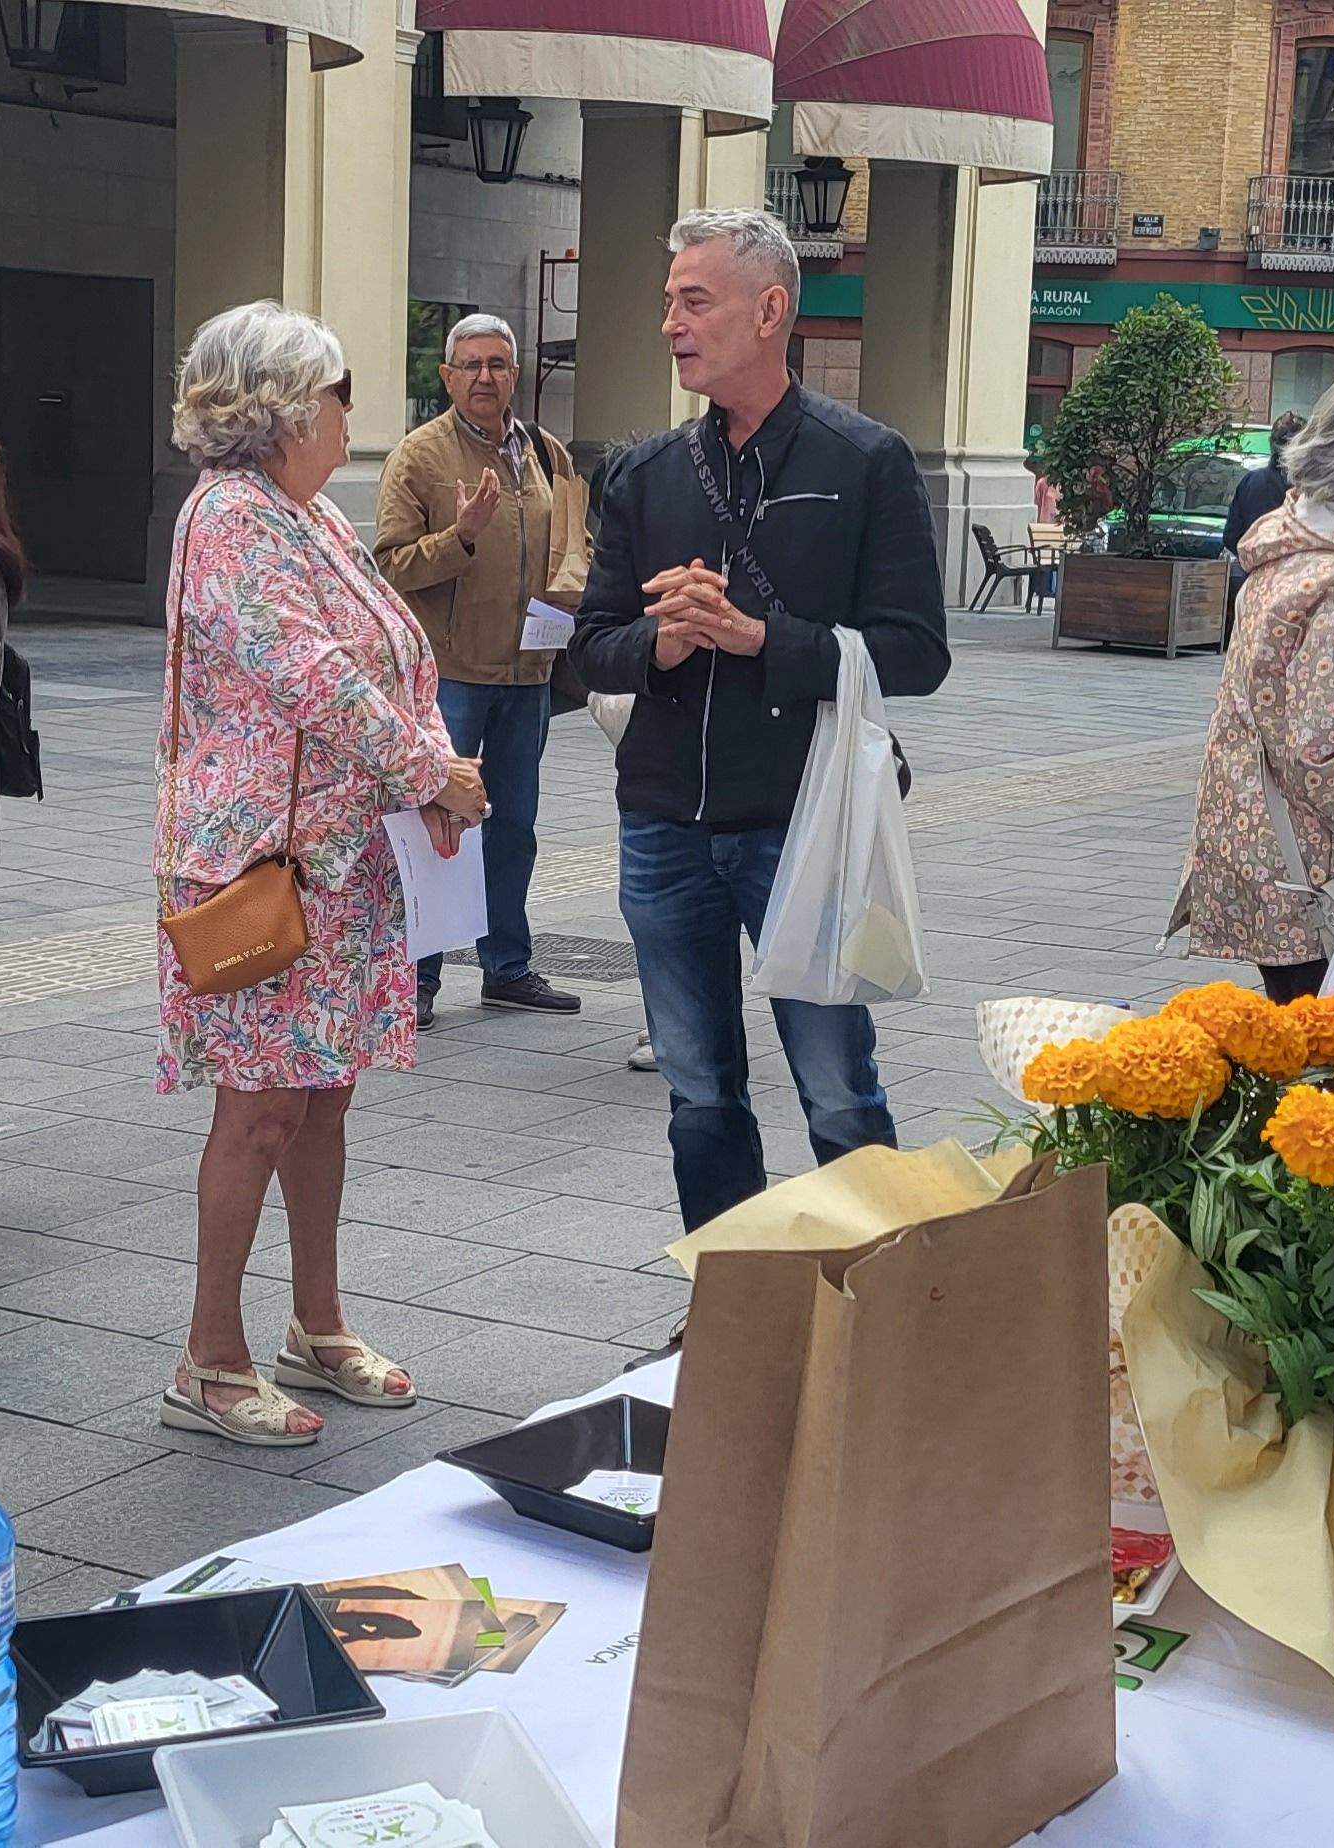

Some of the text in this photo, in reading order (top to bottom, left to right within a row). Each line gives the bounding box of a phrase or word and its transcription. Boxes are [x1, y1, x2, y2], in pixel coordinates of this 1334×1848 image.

[1137, 216, 1159, 224] CALLE
[1043, 291, 1091, 304] RURAL
[698, 464, 733, 522] JAMES
[737, 545, 775, 599] DEAN
[214, 954, 244, 972] BIMBA
[251, 941, 276, 956] LOLA
